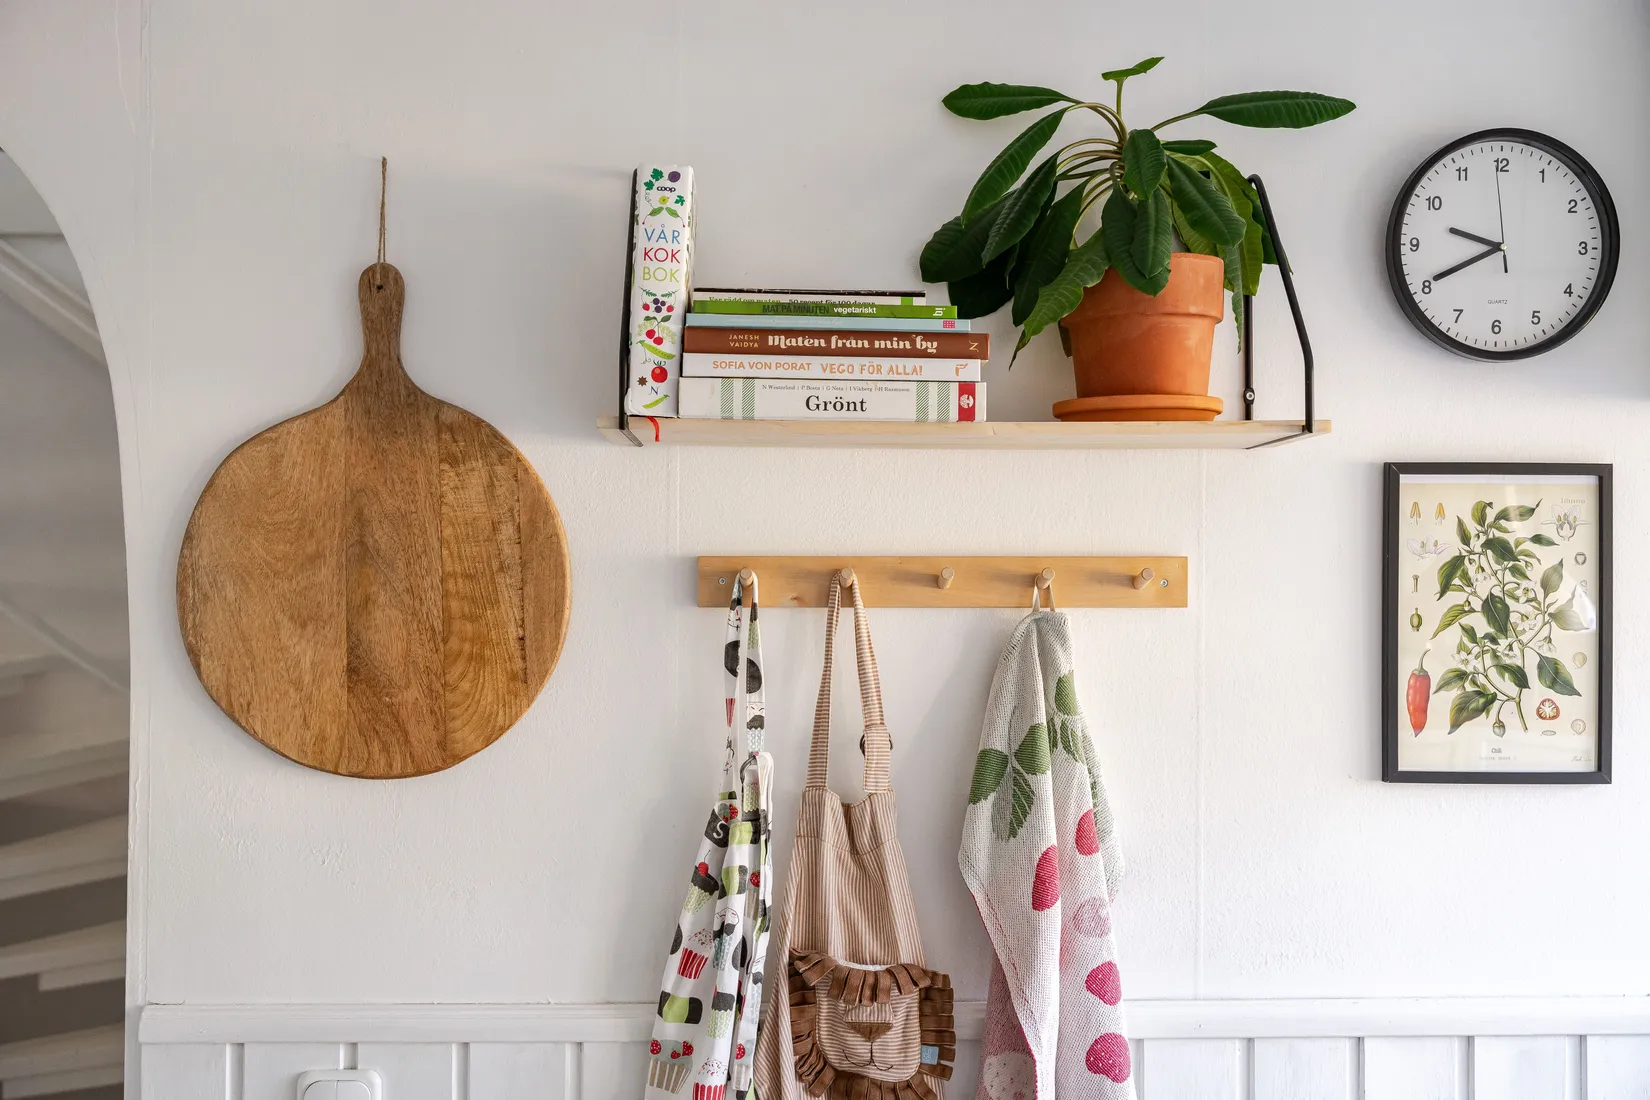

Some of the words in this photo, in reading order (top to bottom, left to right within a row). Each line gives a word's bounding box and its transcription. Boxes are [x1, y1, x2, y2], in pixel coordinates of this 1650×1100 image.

[1494, 158, 1510, 172] 12
[1456, 167, 1468, 182] 11
[1538, 169, 1545, 183] 1
[656, 185, 676, 193] coop
[1426, 196, 1442, 210] 10
[1568, 199, 1578, 214] 2
[644, 223, 681, 245] VÅR
[1409, 237, 1420, 252] 9
[1578, 241, 1588, 256] 3
[643, 246, 681, 264] KOK
[642, 266, 680, 284] BOK
[1422, 280, 1432, 294] 8
[1564, 283, 1574, 298] 4
[762, 304, 779, 312] MAT
[794, 305, 830, 314] MINUTEN
[834, 306, 876, 314] vegetariskt
[1452, 308, 1464, 324] 7
[1531, 310, 1541, 325] 5
[1490, 320, 1502, 335] 6
[768, 335, 828, 348] Maten
[830, 334, 870, 348] från
[874, 337, 912, 349] min
[911, 334, 938, 354] by
[712, 360, 746, 370] SOFIA
[748, 361, 772, 370] VON
[775, 362, 812, 371] PORAT
[820, 363, 854, 374] VEGO
[860, 361, 882, 375] FÖR
[887, 364, 922, 376] ALLA!
[806, 394, 868, 412] Grönt
